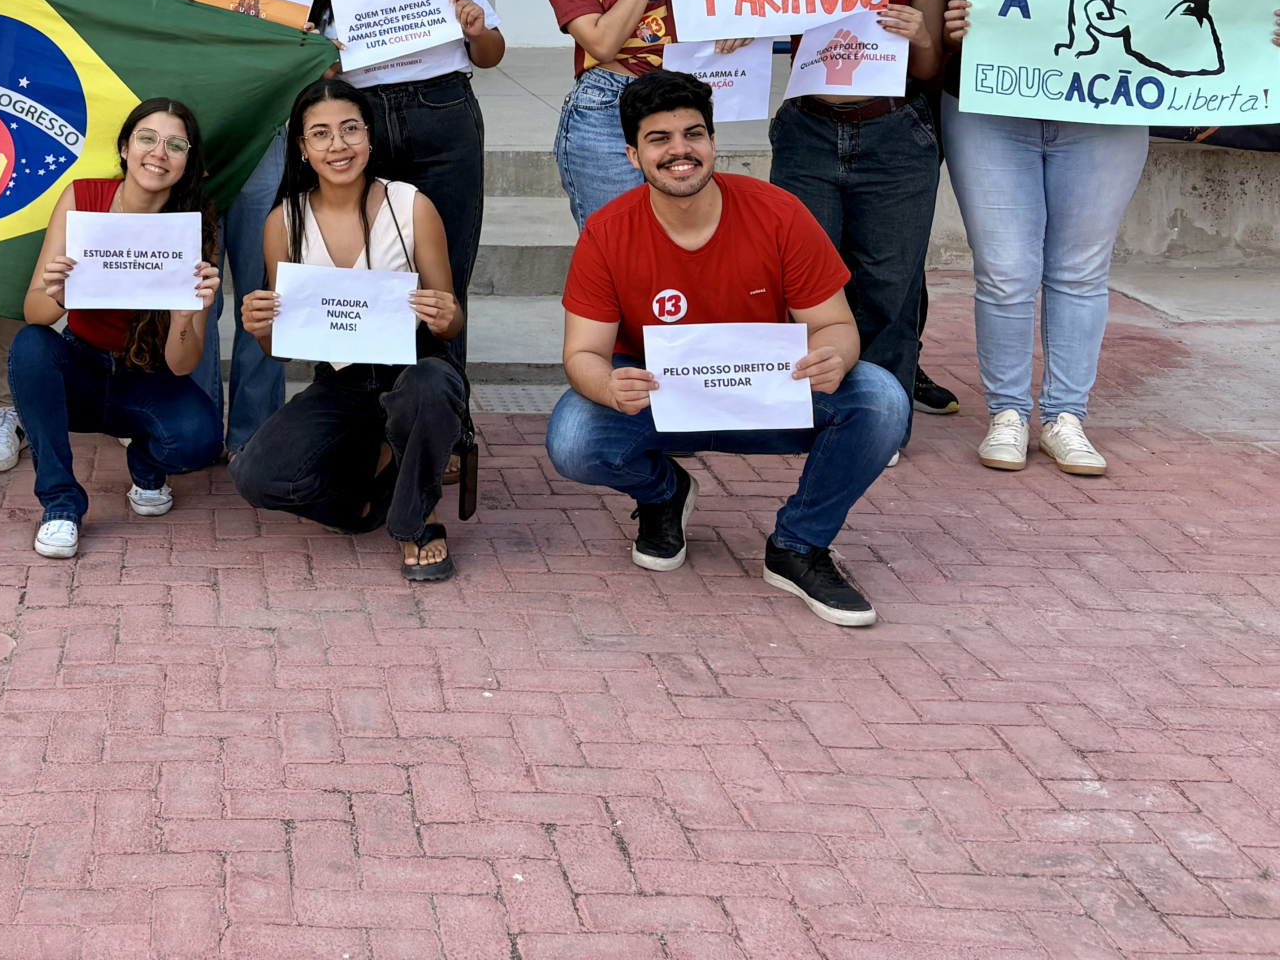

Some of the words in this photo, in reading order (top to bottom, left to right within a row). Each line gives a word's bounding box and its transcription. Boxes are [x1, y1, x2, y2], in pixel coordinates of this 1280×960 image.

[230, 3, 266, 19] TUDO
[354, 11, 379, 22] QUEM
[380, 6, 397, 16] TEM
[398, 0, 431, 12] APENAS
[348, 16, 400, 32] ASPIRAÇÕES
[401, 7, 442, 21] PESSOAIS
[347, 30, 377, 43] JAMAIS
[378, 19, 426, 36] ENTENDERÁ
[427, 16, 447, 27] UMA
[366, 39, 388, 49] LUTA
[388, 29, 431, 45] COLETIVA!
[816, 46, 833, 57] TUDO
[839, 40, 879, 51] POLÍTICO
[800, 55, 829, 70] QUANDO
[829, 51, 852, 60] VOCÊ
[860, 53, 897, 62] MULHER
[693, 71, 708, 80] SSA
[709, 70, 733, 79] ARMA
[734, 68, 739, 77] É
[740, 69, 747, 77] A
[709, 79, 734, 90] AÇÃO
[975, 63, 1165, 110] EDUCAÇÃO
[83, 249, 124, 258] ESTUDAR
[126, 247, 132, 258] É
[133, 250, 149, 259] UM
[150, 251, 170, 259] ATO
[171, 251, 183, 260] DE
[102, 259, 164, 271] RESISTÊNCIA!
[321, 297, 369, 309] DITADURA
[655, 294, 682, 318] 13
[326, 309, 362, 320] NUNCA
[329, 321, 357, 332] MAIS!
[663, 367, 690, 376] PELO
[692, 365, 731, 376] NOSSO
[733, 362, 775, 374] DIREITO
[777, 362, 791, 371] DE
[704, 377, 753, 388] ESTUDAR
